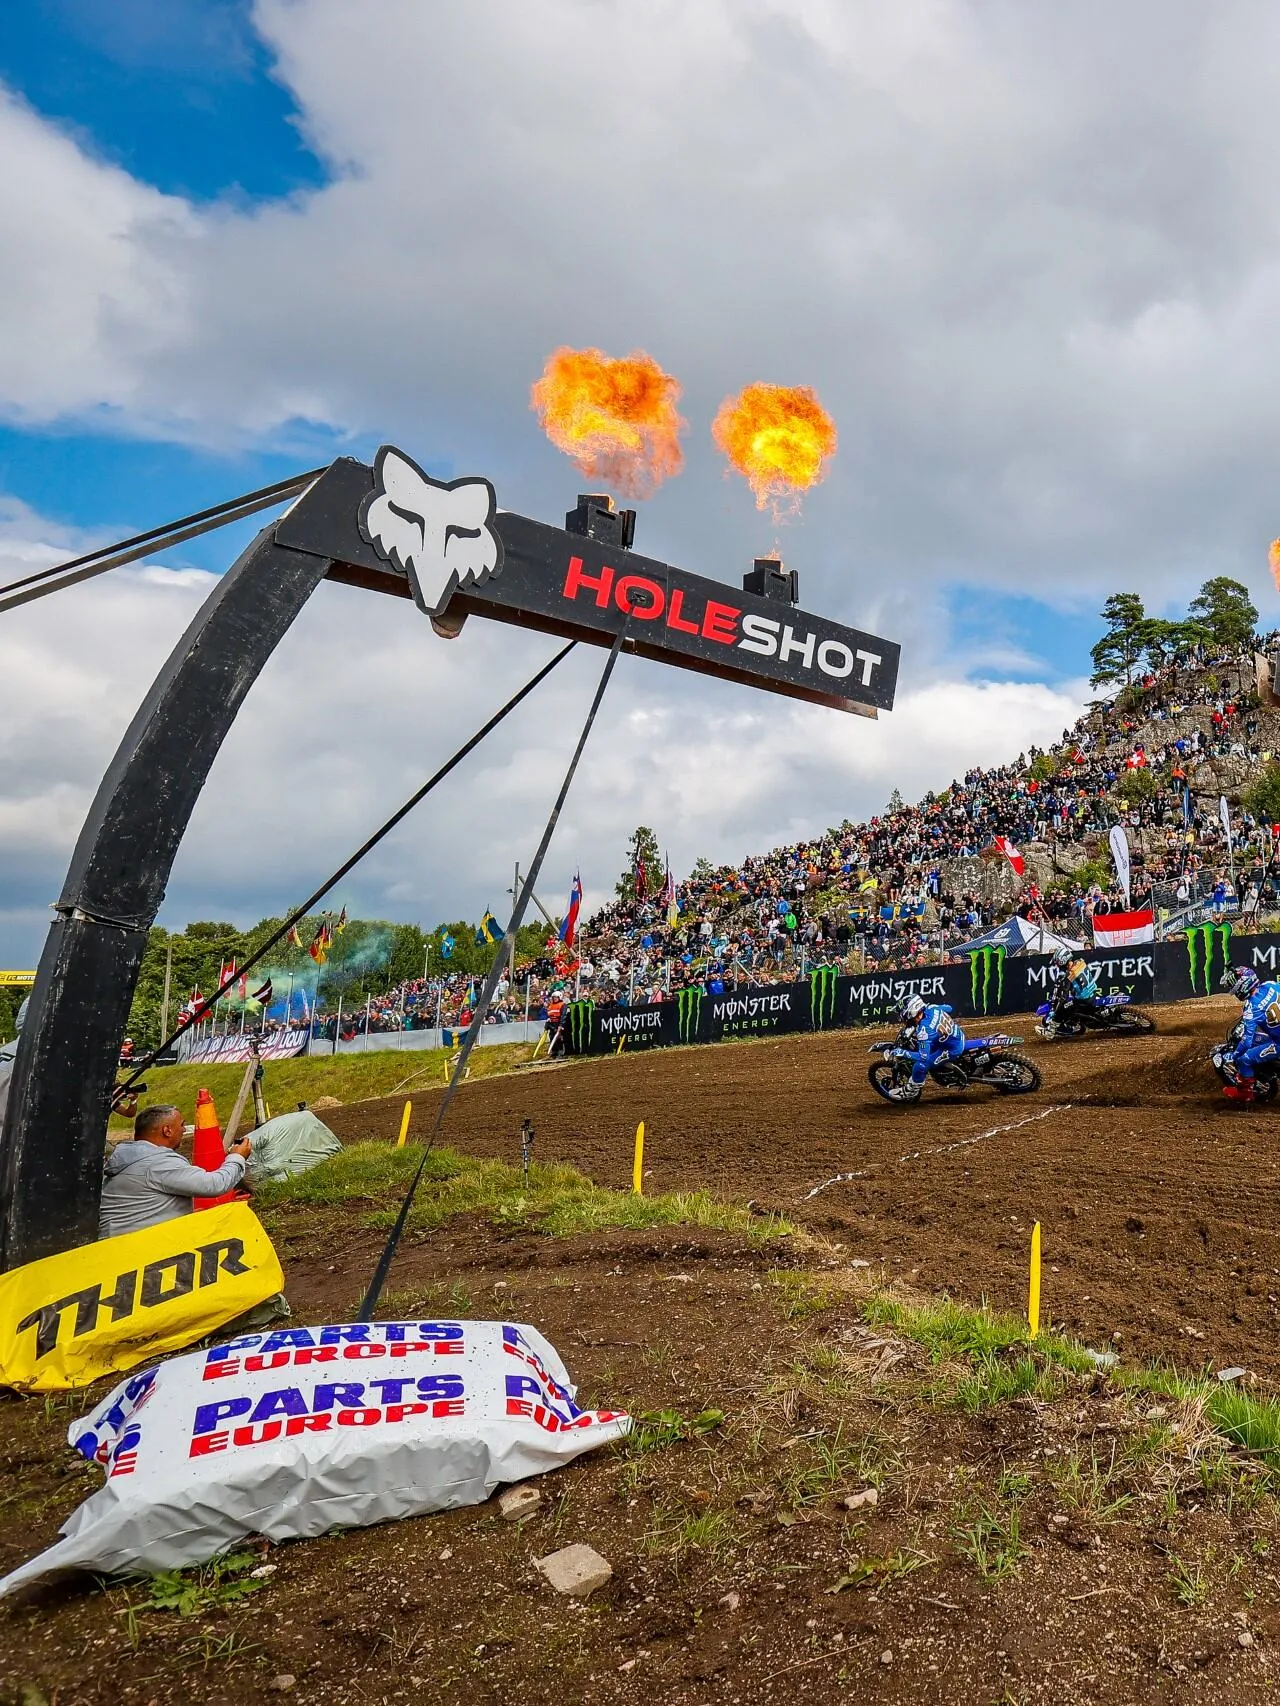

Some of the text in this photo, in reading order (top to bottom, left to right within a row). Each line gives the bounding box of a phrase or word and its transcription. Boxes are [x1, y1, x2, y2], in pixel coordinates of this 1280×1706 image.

[562, 556, 882, 687] HOLESHOT
[713, 993, 792, 1020] MONSTER
[850, 976, 947, 1005] MONSTER
[601, 1011, 662, 1034] MONSTER
[723, 1017, 779, 1031] ENERGY
[16, 1238, 252, 1361] THOR
[202, 1341, 465, 1381] EUROPE
[206, 1322, 464, 1363] PARTS
[192, 1374, 465, 1436] PARTS
[189, 1399, 465, 1458] EUROPE
